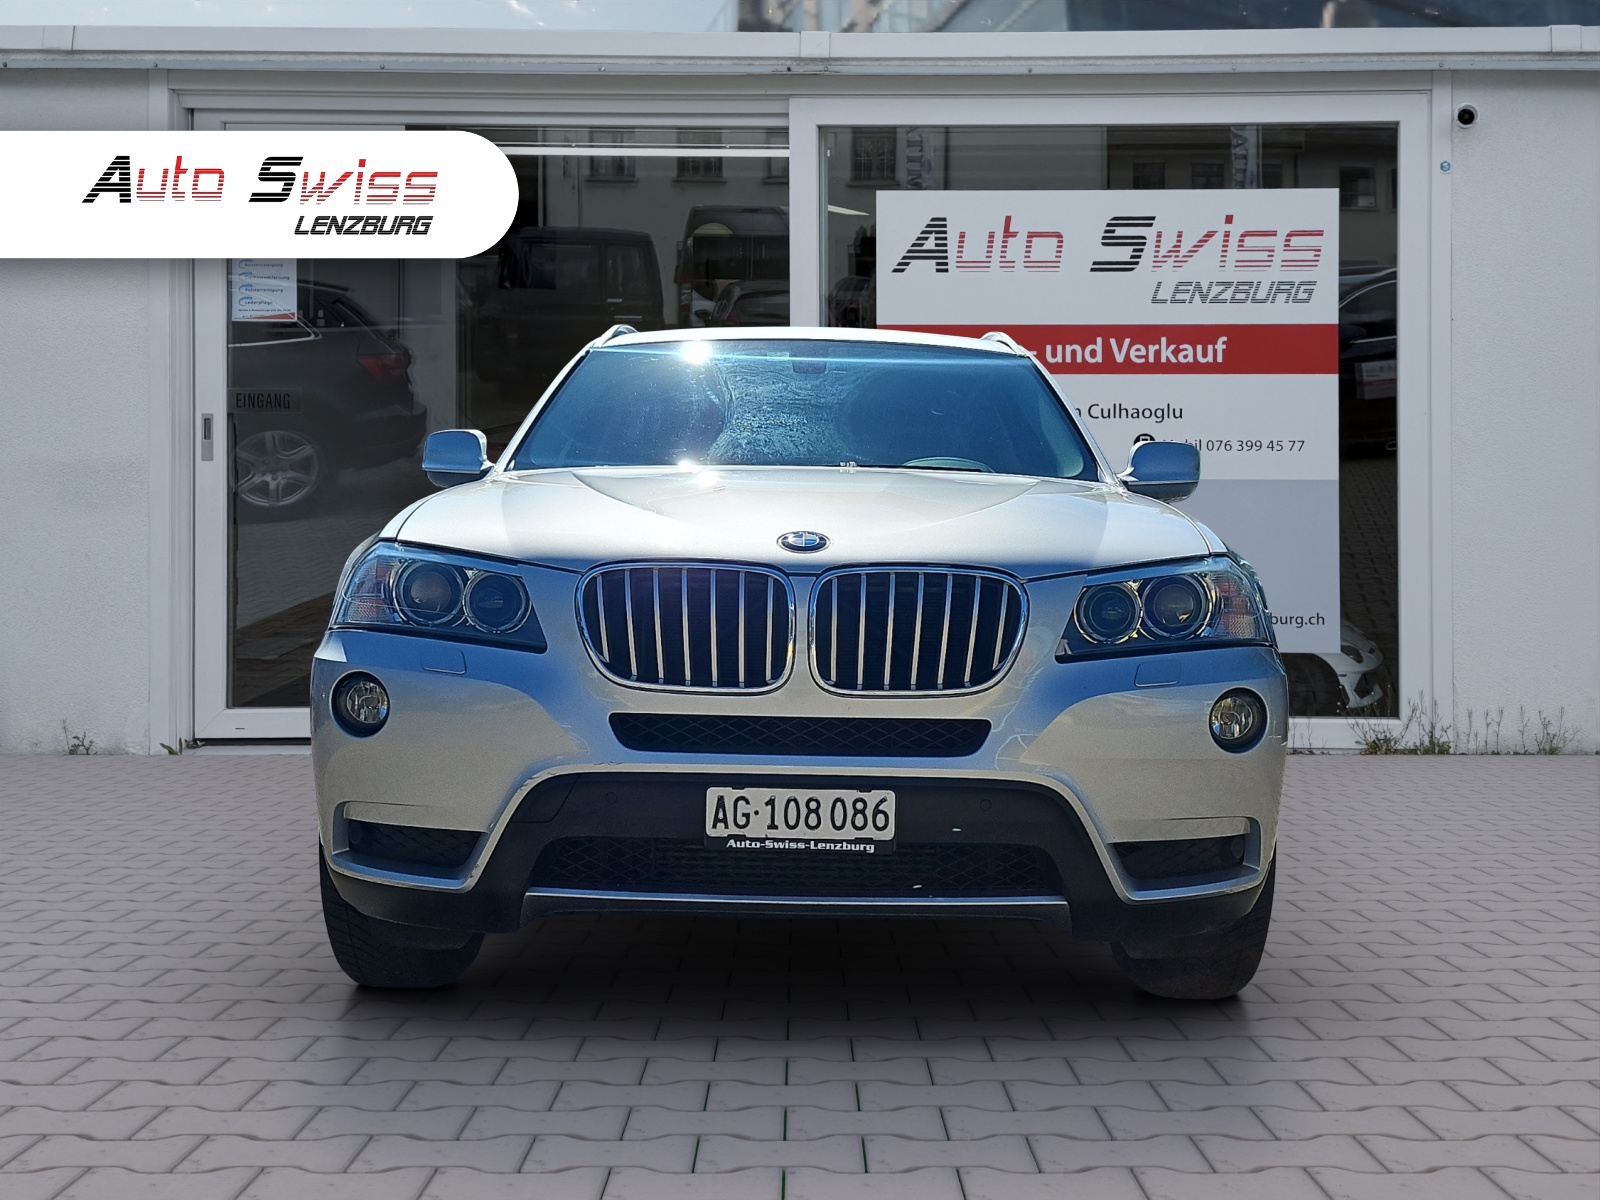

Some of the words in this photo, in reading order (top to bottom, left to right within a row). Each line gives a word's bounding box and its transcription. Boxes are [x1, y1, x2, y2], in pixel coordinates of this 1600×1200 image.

[892, 216, 1063, 273] Auto
[1090, 215, 1324, 272] Swiss
[1151, 280, 1317, 304] LENZBURG
[1045, 337, 1102, 364] und
[1109, 336, 1228, 363] Verkauf
[236, 393, 290, 409] EINGANG
[1087, 403, 1183, 424] Culhaoglu
[1206, 439, 1233, 452] 076
[1236, 439, 1263, 452] 399
[1266, 439, 1284, 452] 45
[1288, 439, 1305, 452] 77
[726, 839, 875, 854] Auto-Swiss-Lenzburg
